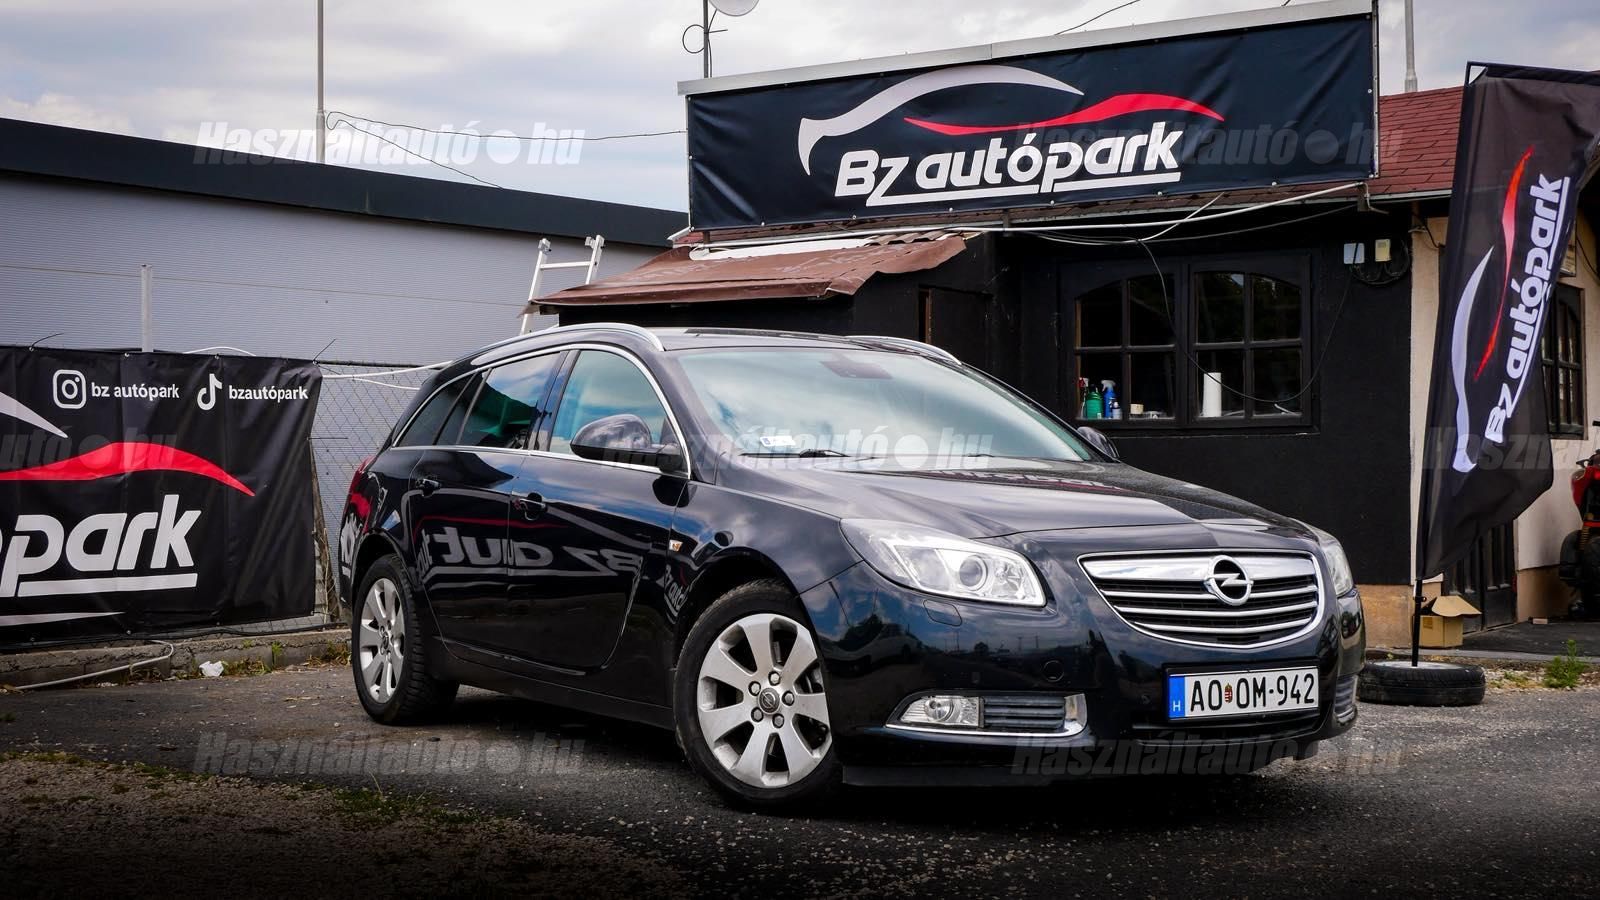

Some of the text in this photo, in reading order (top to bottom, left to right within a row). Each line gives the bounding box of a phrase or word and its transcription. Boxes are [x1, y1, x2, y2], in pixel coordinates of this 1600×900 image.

[834, 121, 1184, 207] Bz autópark
[1484, 173, 1563, 443] Bz autópark
[91, 382, 179, 401] bz autópark
[228, 385, 309, 403] bzautópark
[1173, 701, 1181, 712] H
[1190, 679, 1223, 712] AO
